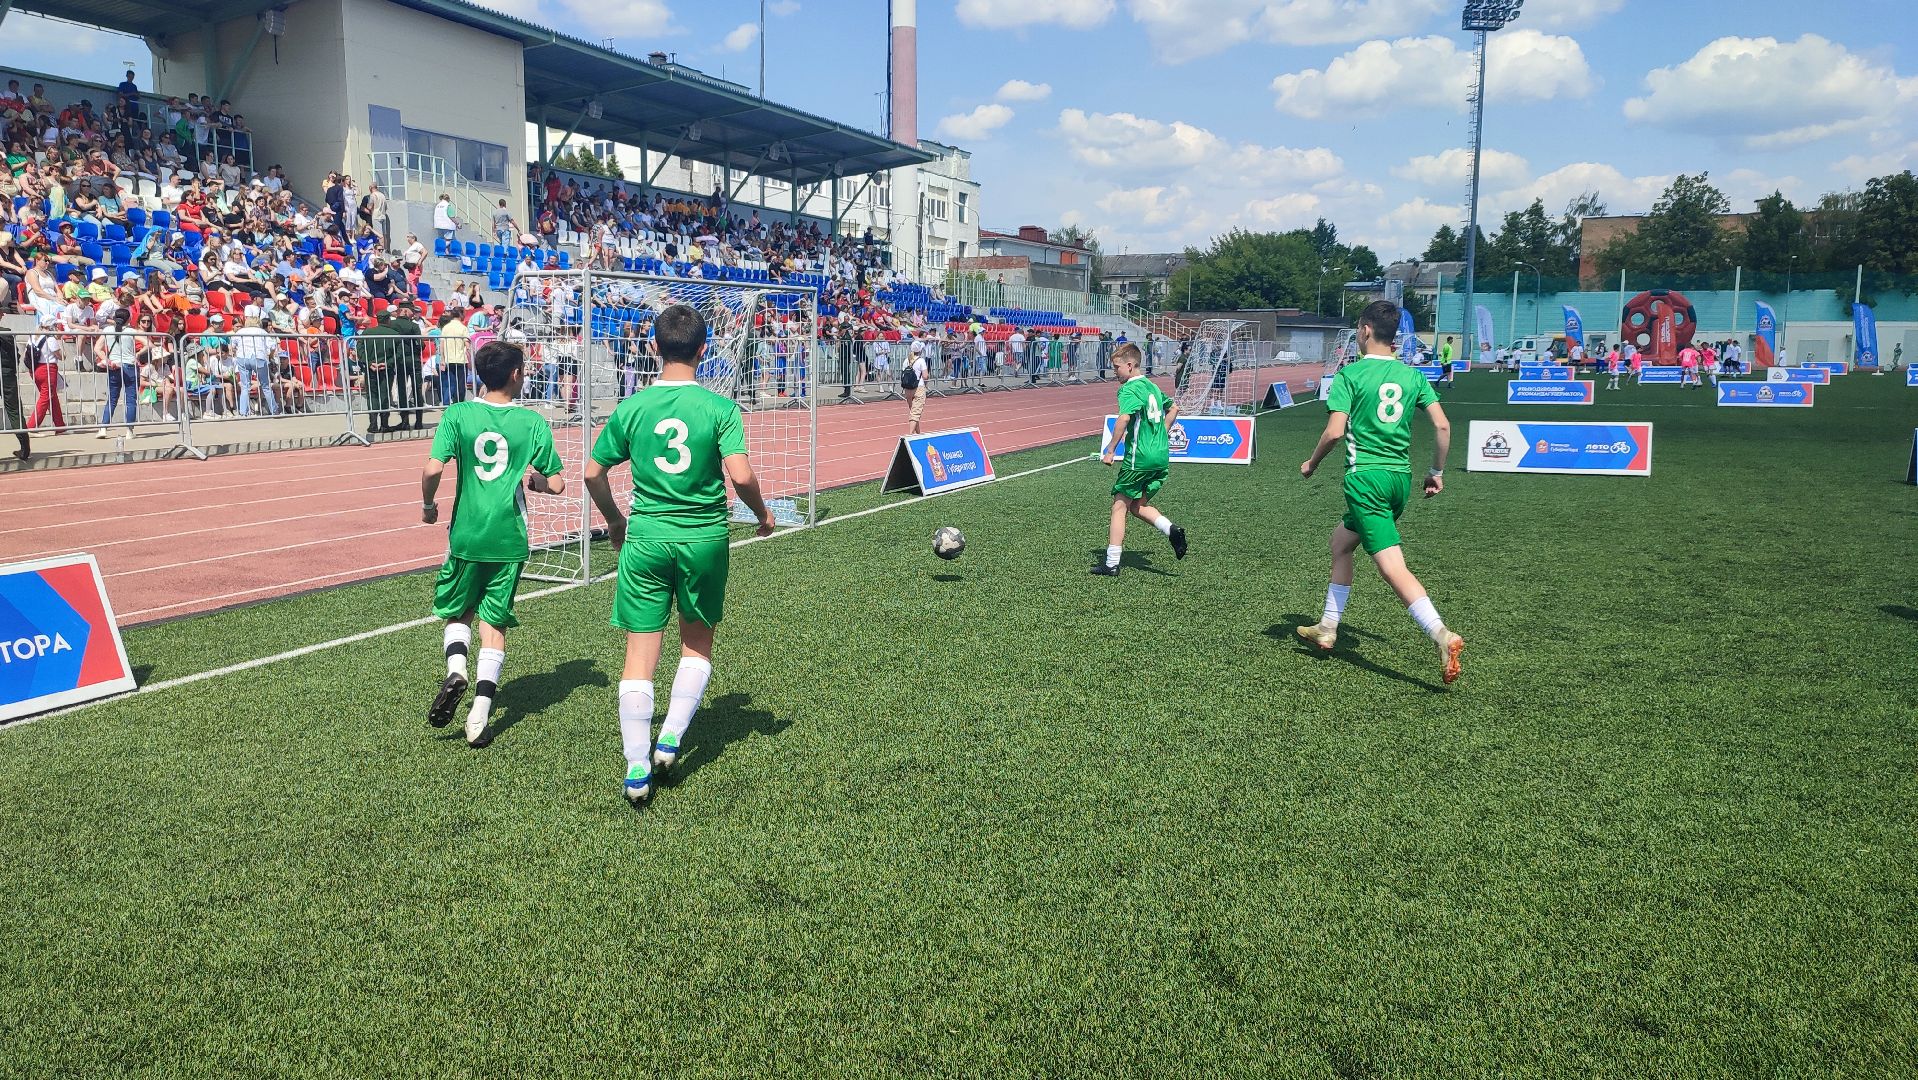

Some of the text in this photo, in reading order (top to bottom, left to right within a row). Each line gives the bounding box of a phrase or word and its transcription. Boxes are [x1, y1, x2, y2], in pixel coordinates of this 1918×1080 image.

[1149, 393, 1163, 424] 4
[1378, 382, 1404, 424] 8
[473, 431, 509, 482] 9
[653, 418, 692, 474] 3
[946, 461, 977, 476] Губернатора
[0, 632, 72, 664] ТОРА
